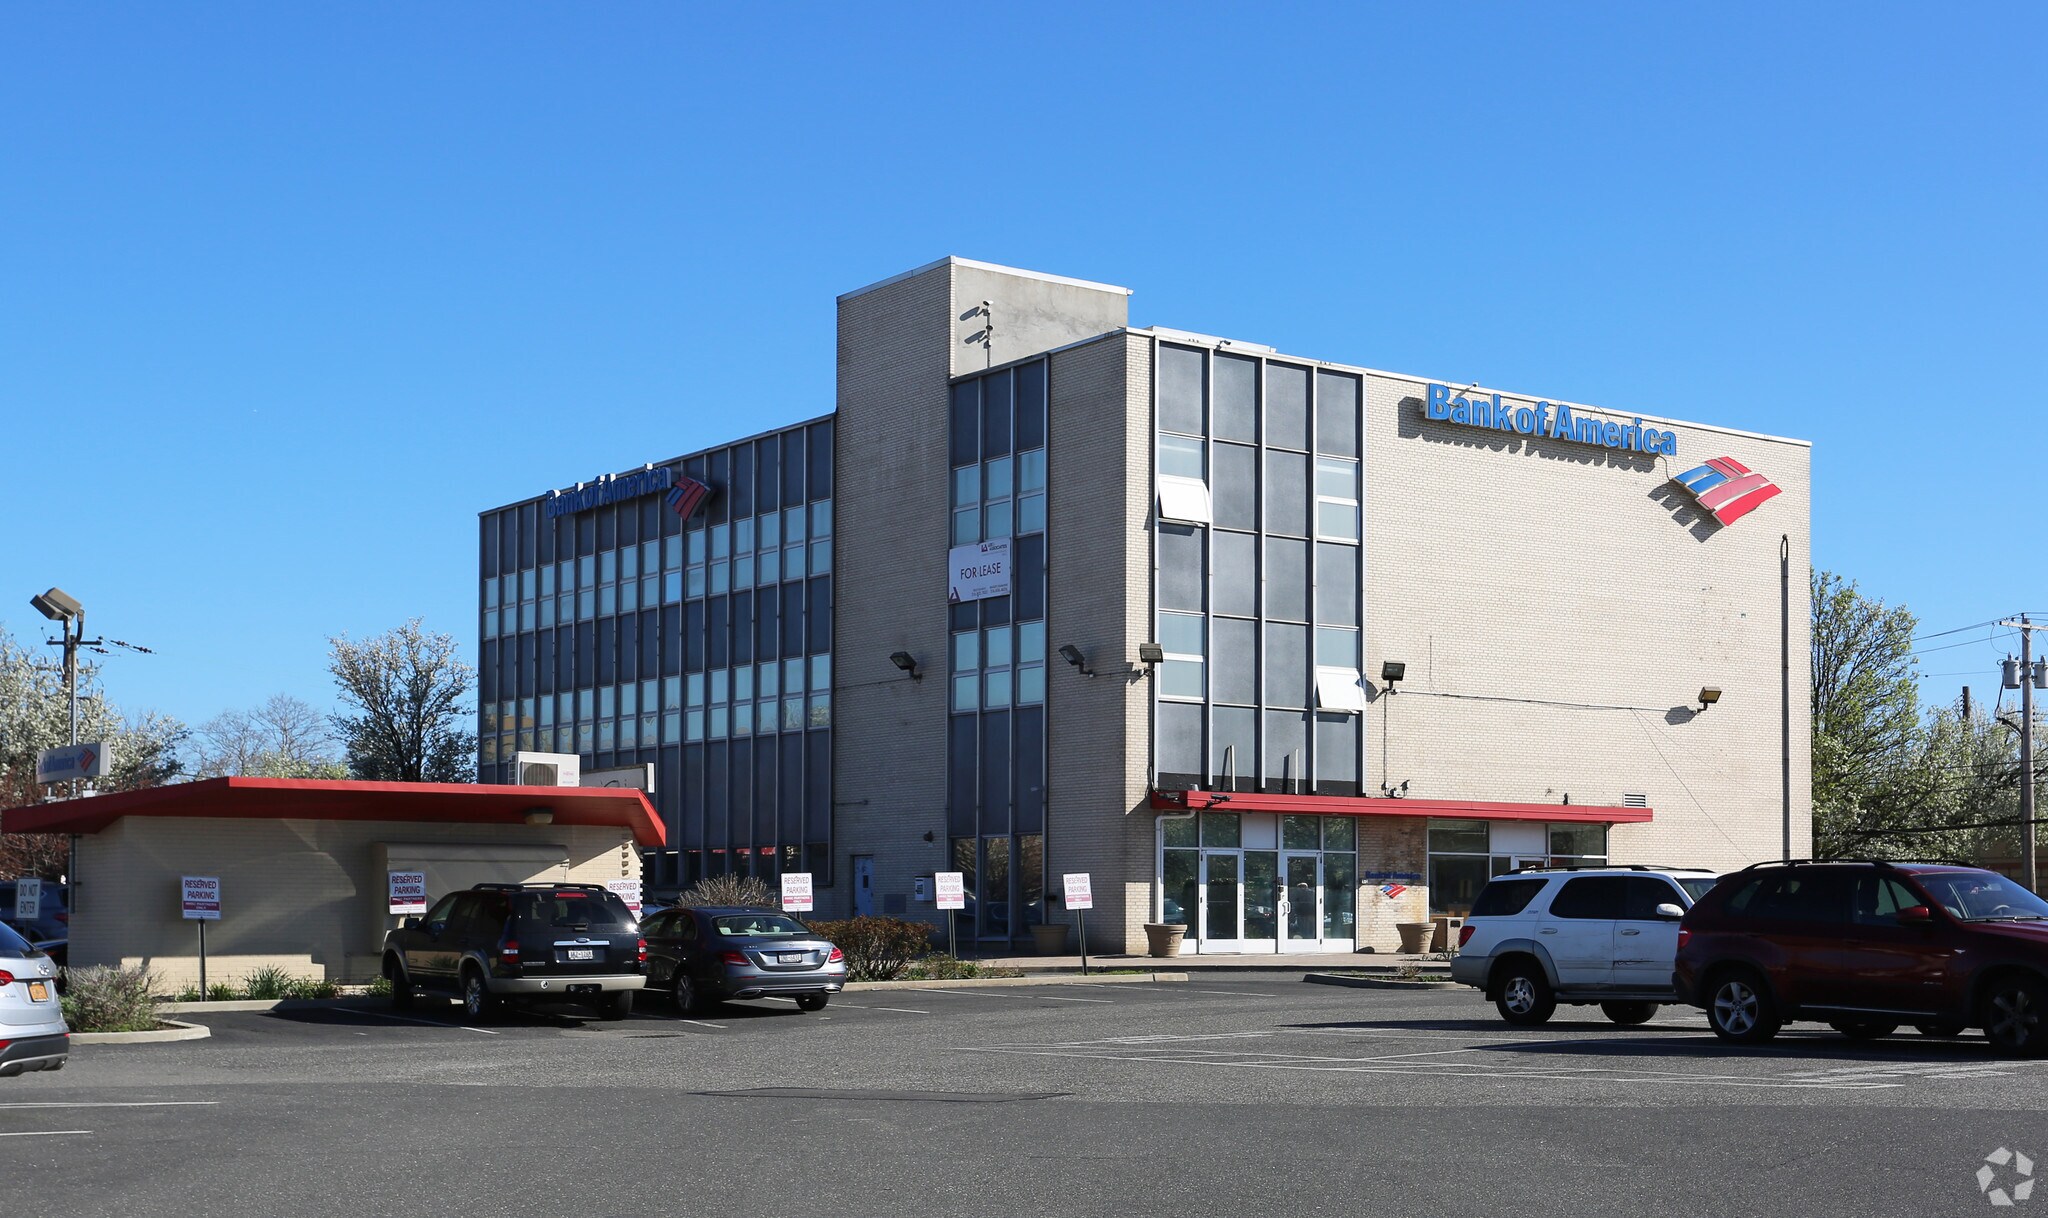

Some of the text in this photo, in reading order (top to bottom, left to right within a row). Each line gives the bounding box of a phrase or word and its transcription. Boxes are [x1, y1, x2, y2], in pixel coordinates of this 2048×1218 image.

[1426, 383, 1678, 456] Bank of America
[546, 463, 671, 518] Bank of America
[960, 562, 1001, 580] FOR LEASE
[392, 875, 423, 884] RESERVED
[784, 876, 810, 885] RESERVED
[937, 875, 961, 883] RESERVED
[1066, 876, 1088, 884] RESERVED
[184, 879, 217, 889] RESERVED
[608, 882, 637, 891] RESERVED
[940, 884, 960, 892] PARKING
[20, 884, 38, 896] DO NOT
[394, 885, 421, 894] PARKING
[786, 886, 809, 894] PARKING
[187, 890, 215, 900] PARKING
[20, 901, 36, 914] ENTER
